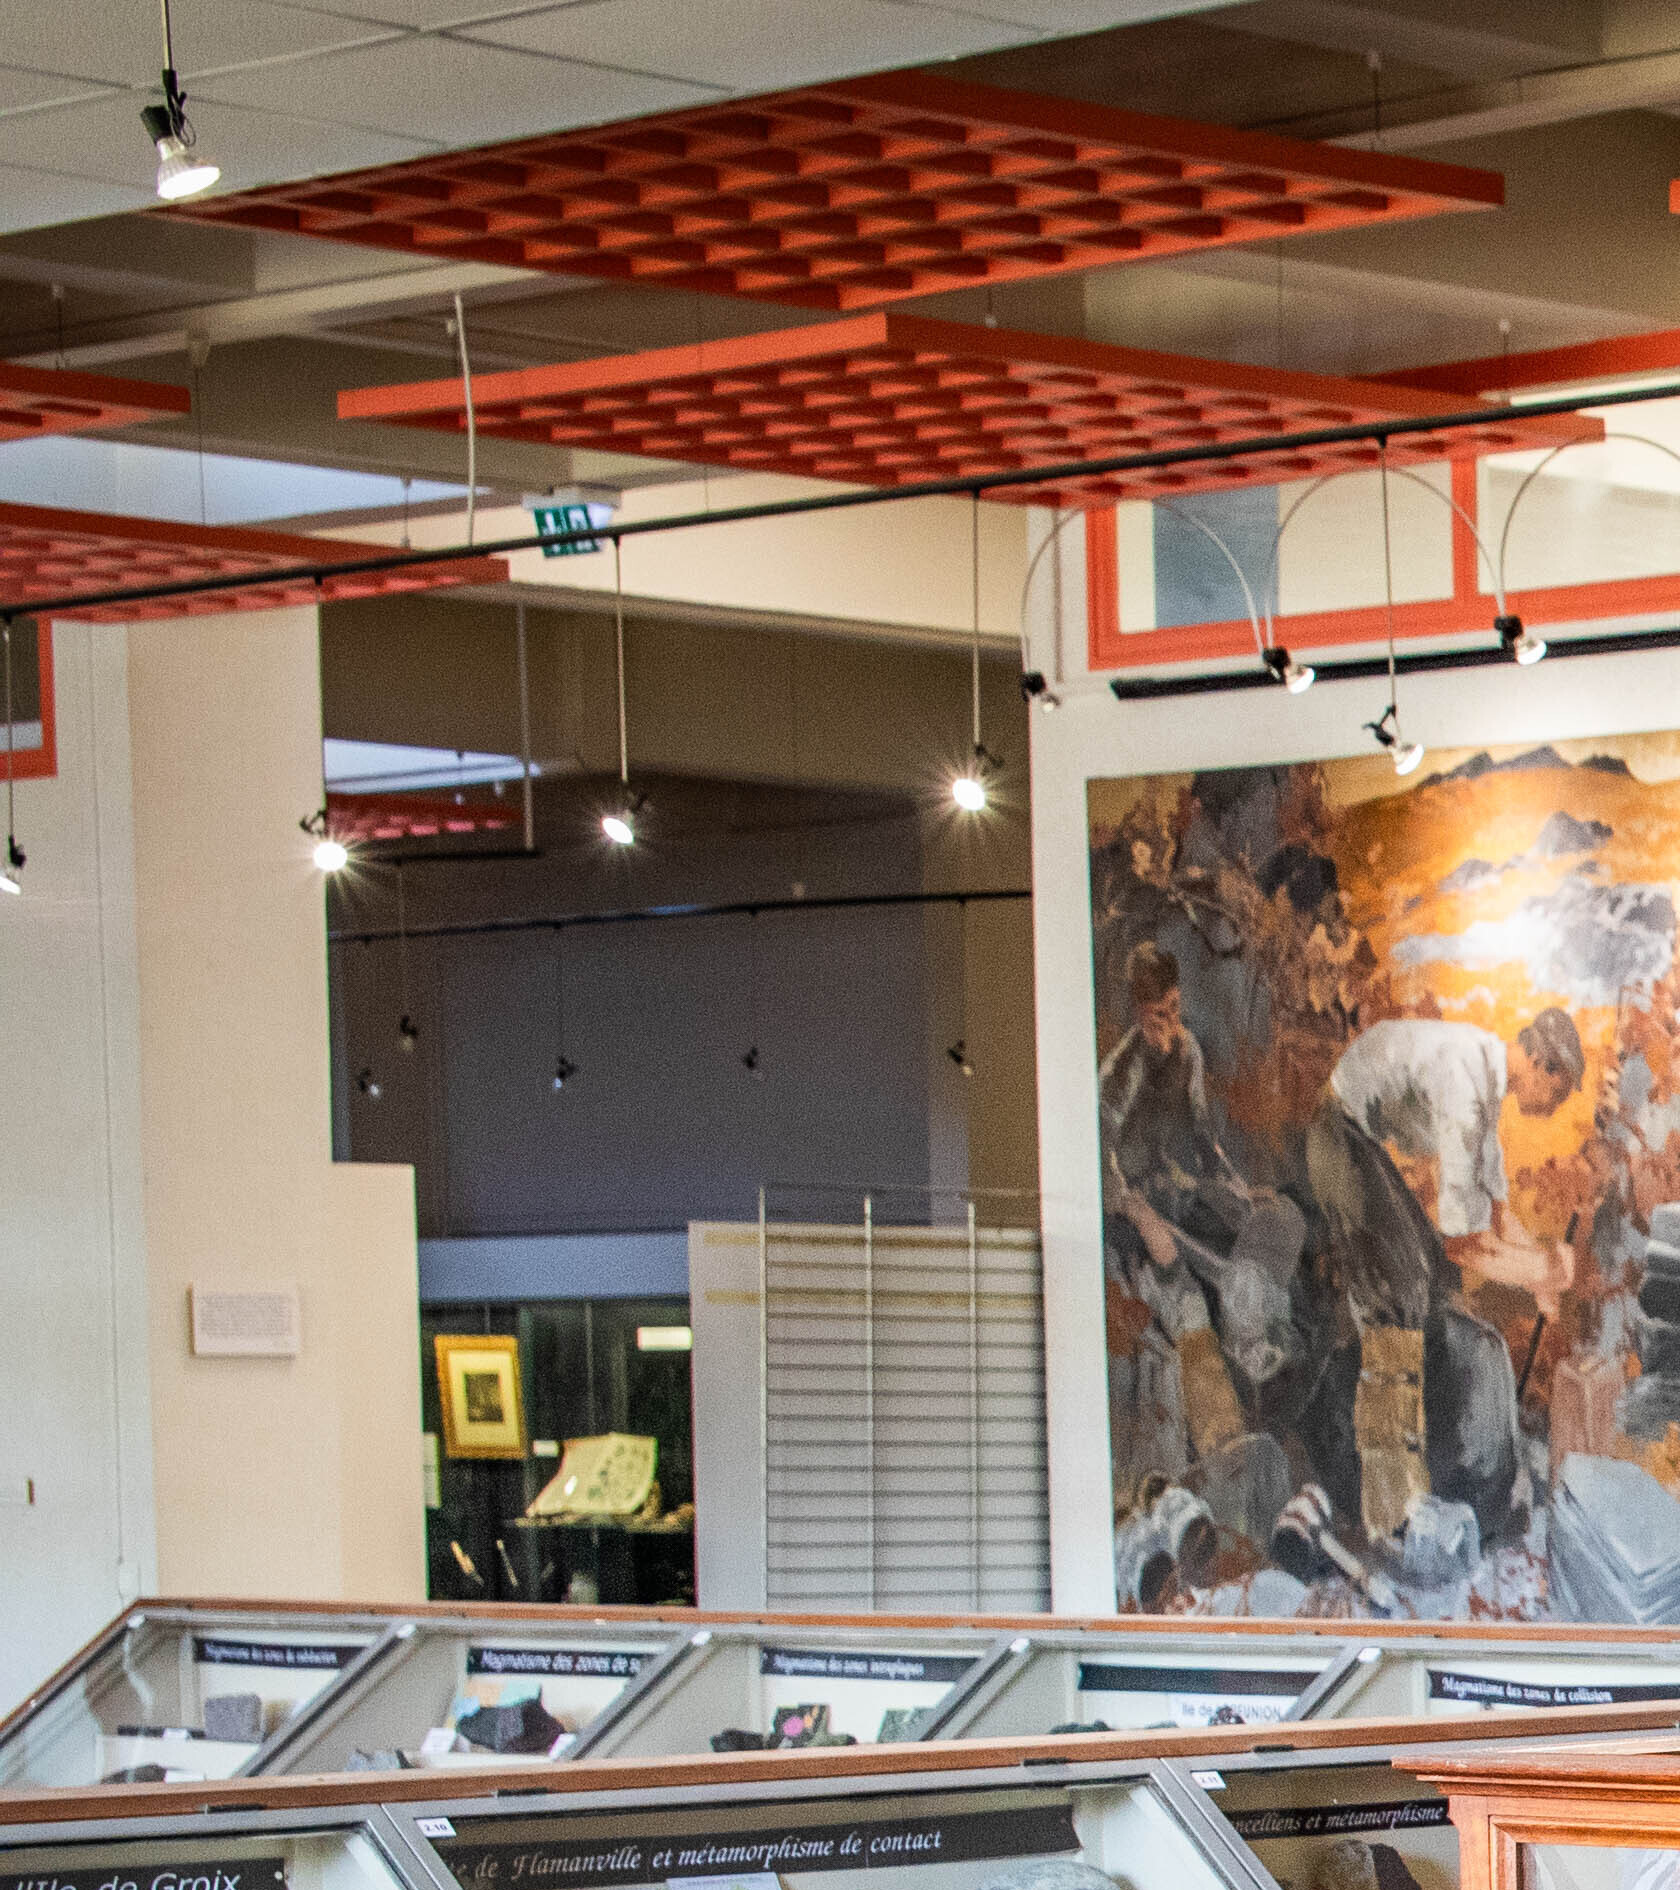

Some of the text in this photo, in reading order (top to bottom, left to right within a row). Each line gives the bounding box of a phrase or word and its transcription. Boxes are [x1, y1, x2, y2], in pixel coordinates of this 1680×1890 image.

[511, 1845, 642, 1881] Flamanville
[652, 1848, 672, 1868] et
[677, 1835, 835, 1871] métamorphisme
[840, 1830, 862, 1855] de
[870, 1829, 942, 1853] contact
